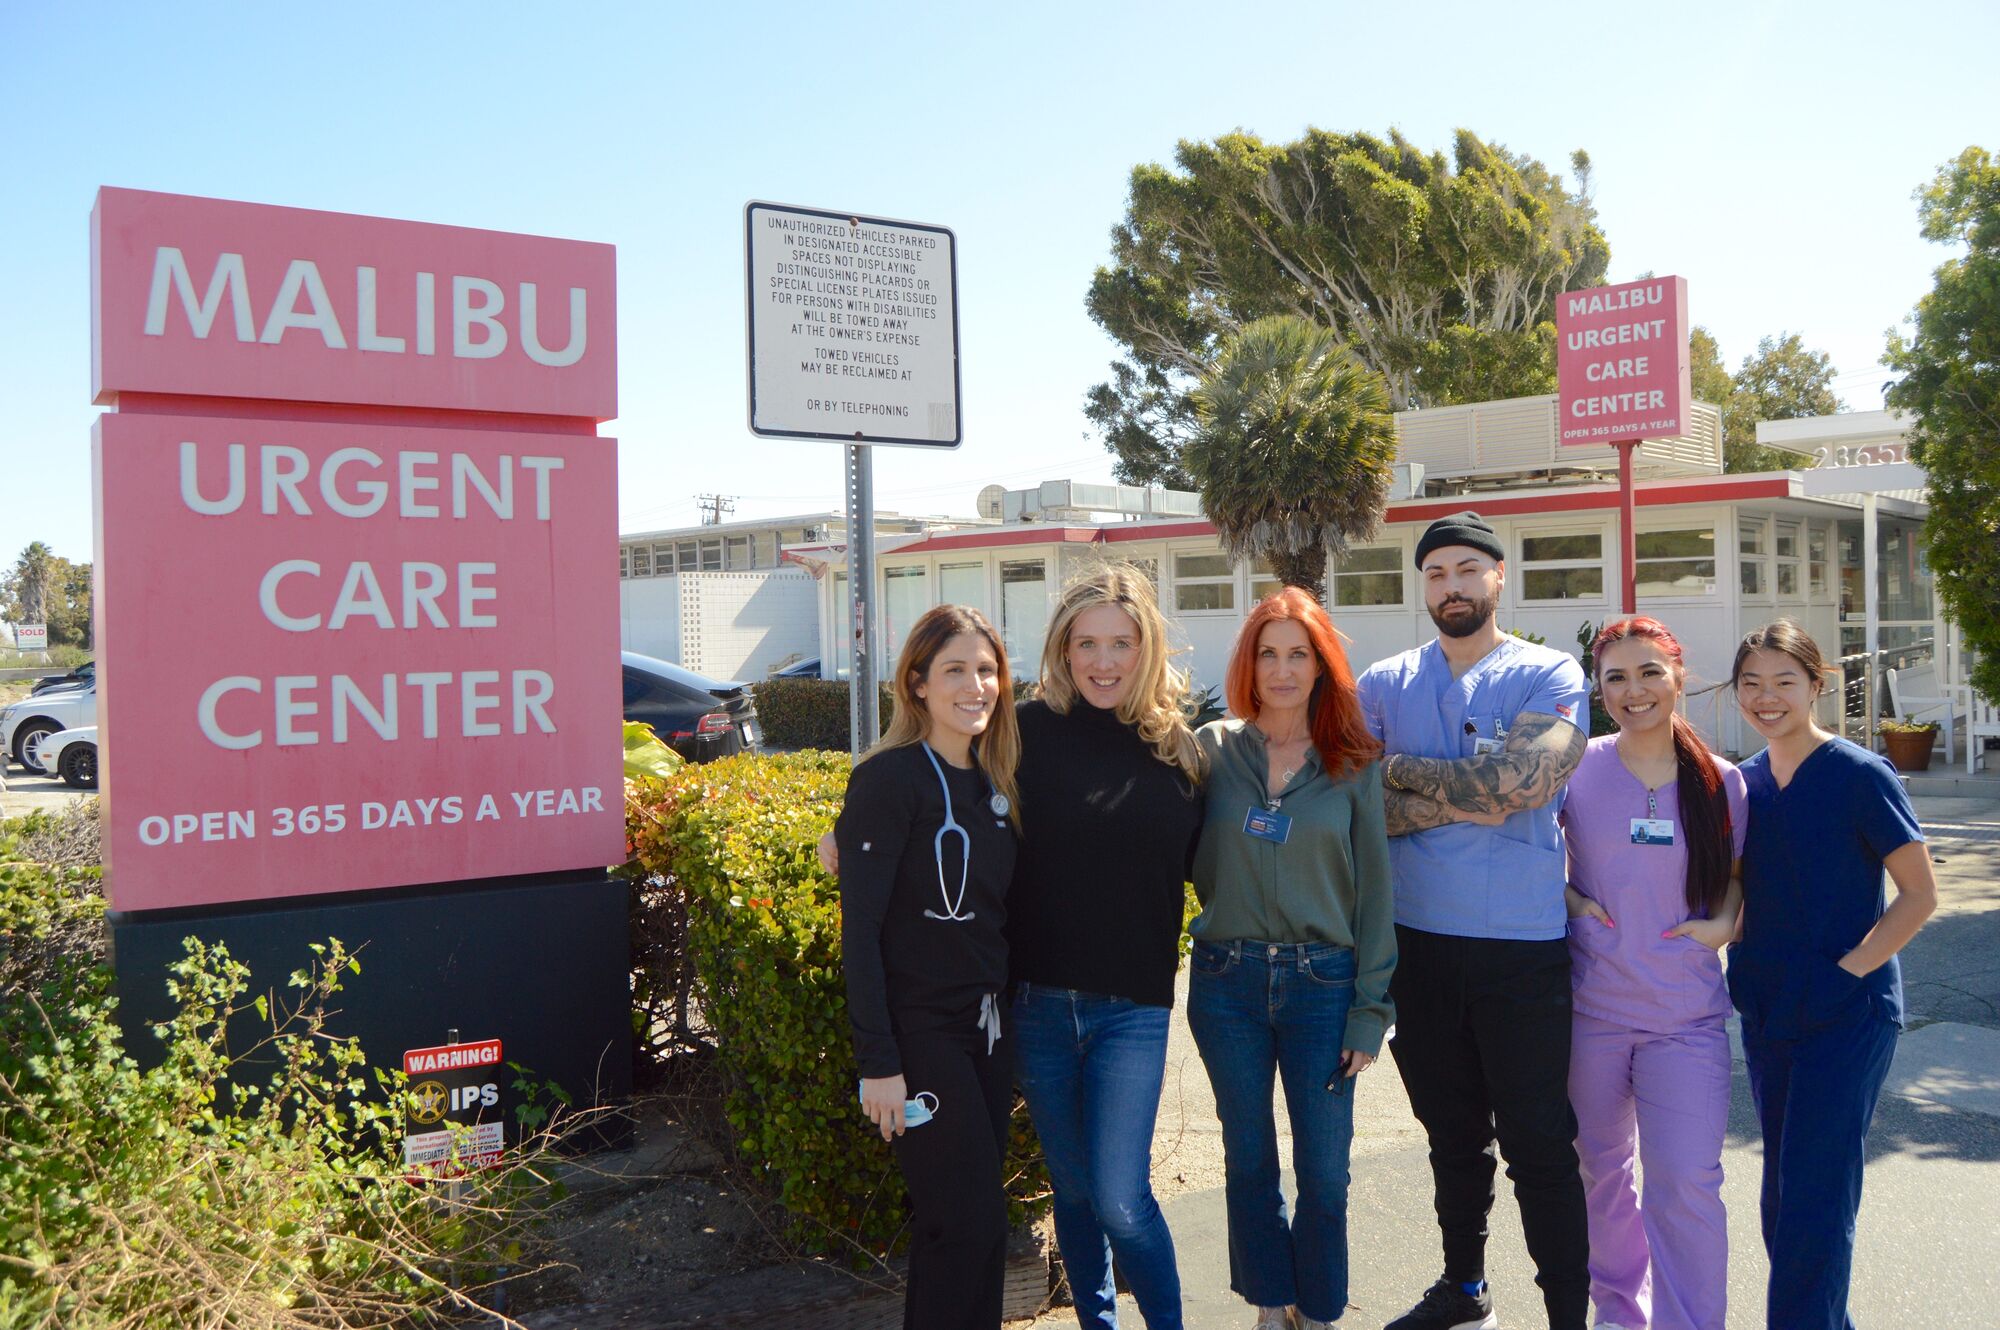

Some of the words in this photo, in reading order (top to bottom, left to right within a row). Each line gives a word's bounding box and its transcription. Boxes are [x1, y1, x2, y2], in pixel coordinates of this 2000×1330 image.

[768, 217, 846, 238] UNAUTHORIZED
[848, 228, 896, 244] VEHICLES
[899, 234, 936, 249] PARKED
[784, 234, 794, 245] IN
[798, 235, 859, 254] DESIGNATED
[863, 244, 922, 262] ACCESSIBLE
[792, 249, 831, 265] SPACES
[835, 255, 854, 267] NOT
[857, 257, 916, 275] DISPLAYING
[777, 262, 858, 282] DISTINGUISHING
[862, 272, 914, 289] PLACARDS
[917, 279, 930, 290] OR
[770, 276, 813, 292] SPECIAL
[817, 282, 858, 297] LICENSE
[862, 287, 899, 301] PLATES
[902, 292, 937, 305] ISSUED
[1569, 285, 1662, 317] MALIBU
[145, 246, 588, 367] MALIBU
[772, 291, 792, 304] FOR
[796, 294, 843, 310] PERSONS
[846, 300, 870, 312] WITH
[874, 302, 936, 320] DISABILITIES
[803, 310, 826, 323] WILL
[830, 312, 843, 324] BE
[846, 314, 879, 328] TOWED
[882, 318, 908, 330] AWAY
[791, 323, 803, 334] AT
[806, 324, 825, 337] THE
[829, 327, 872, 342] OWNER'S
[876, 332, 920, 346] EXPENSE
[1568, 320, 1665, 350] URGENT
[801, 361, 822, 373] MAY
[825, 363, 838, 375] BE
[842, 364, 898, 380] RECLAIMED
[901, 370, 912, 381] AT
[815, 348, 848, 361] TOWED
[852, 351, 899, 366] VEHICLES
[1586, 357, 1648, 381] CARE
[807, 398, 821, 410] OR
[824, 400, 838, 412] BY
[841, 401, 908, 417] TELEPHONING
[1572, 390, 1665, 417] CENTER
[1564, 429, 1589, 439] OPEN
[1592, 427, 1609, 435] 365
[1612, 423, 1638, 433] DAYS
[1640, 422, 1647, 430] A
[1650, 420, 1676, 429] YEAR
[181, 442, 565, 521] URGENT
[259, 559, 498, 632] CARE
[199, 669, 558, 750] CENTER
[139, 809, 256, 845] OPEN
[272, 804, 347, 836] 365
[361, 794, 464, 830] DAYS
[475, 794, 501, 821] A
[511, 787, 604, 818] YEAR
[408, 1046, 498, 1072] WARNING!
[451, 1083, 499, 1111] IPS
[410, 1148, 445, 1163] IMMEDIATE
